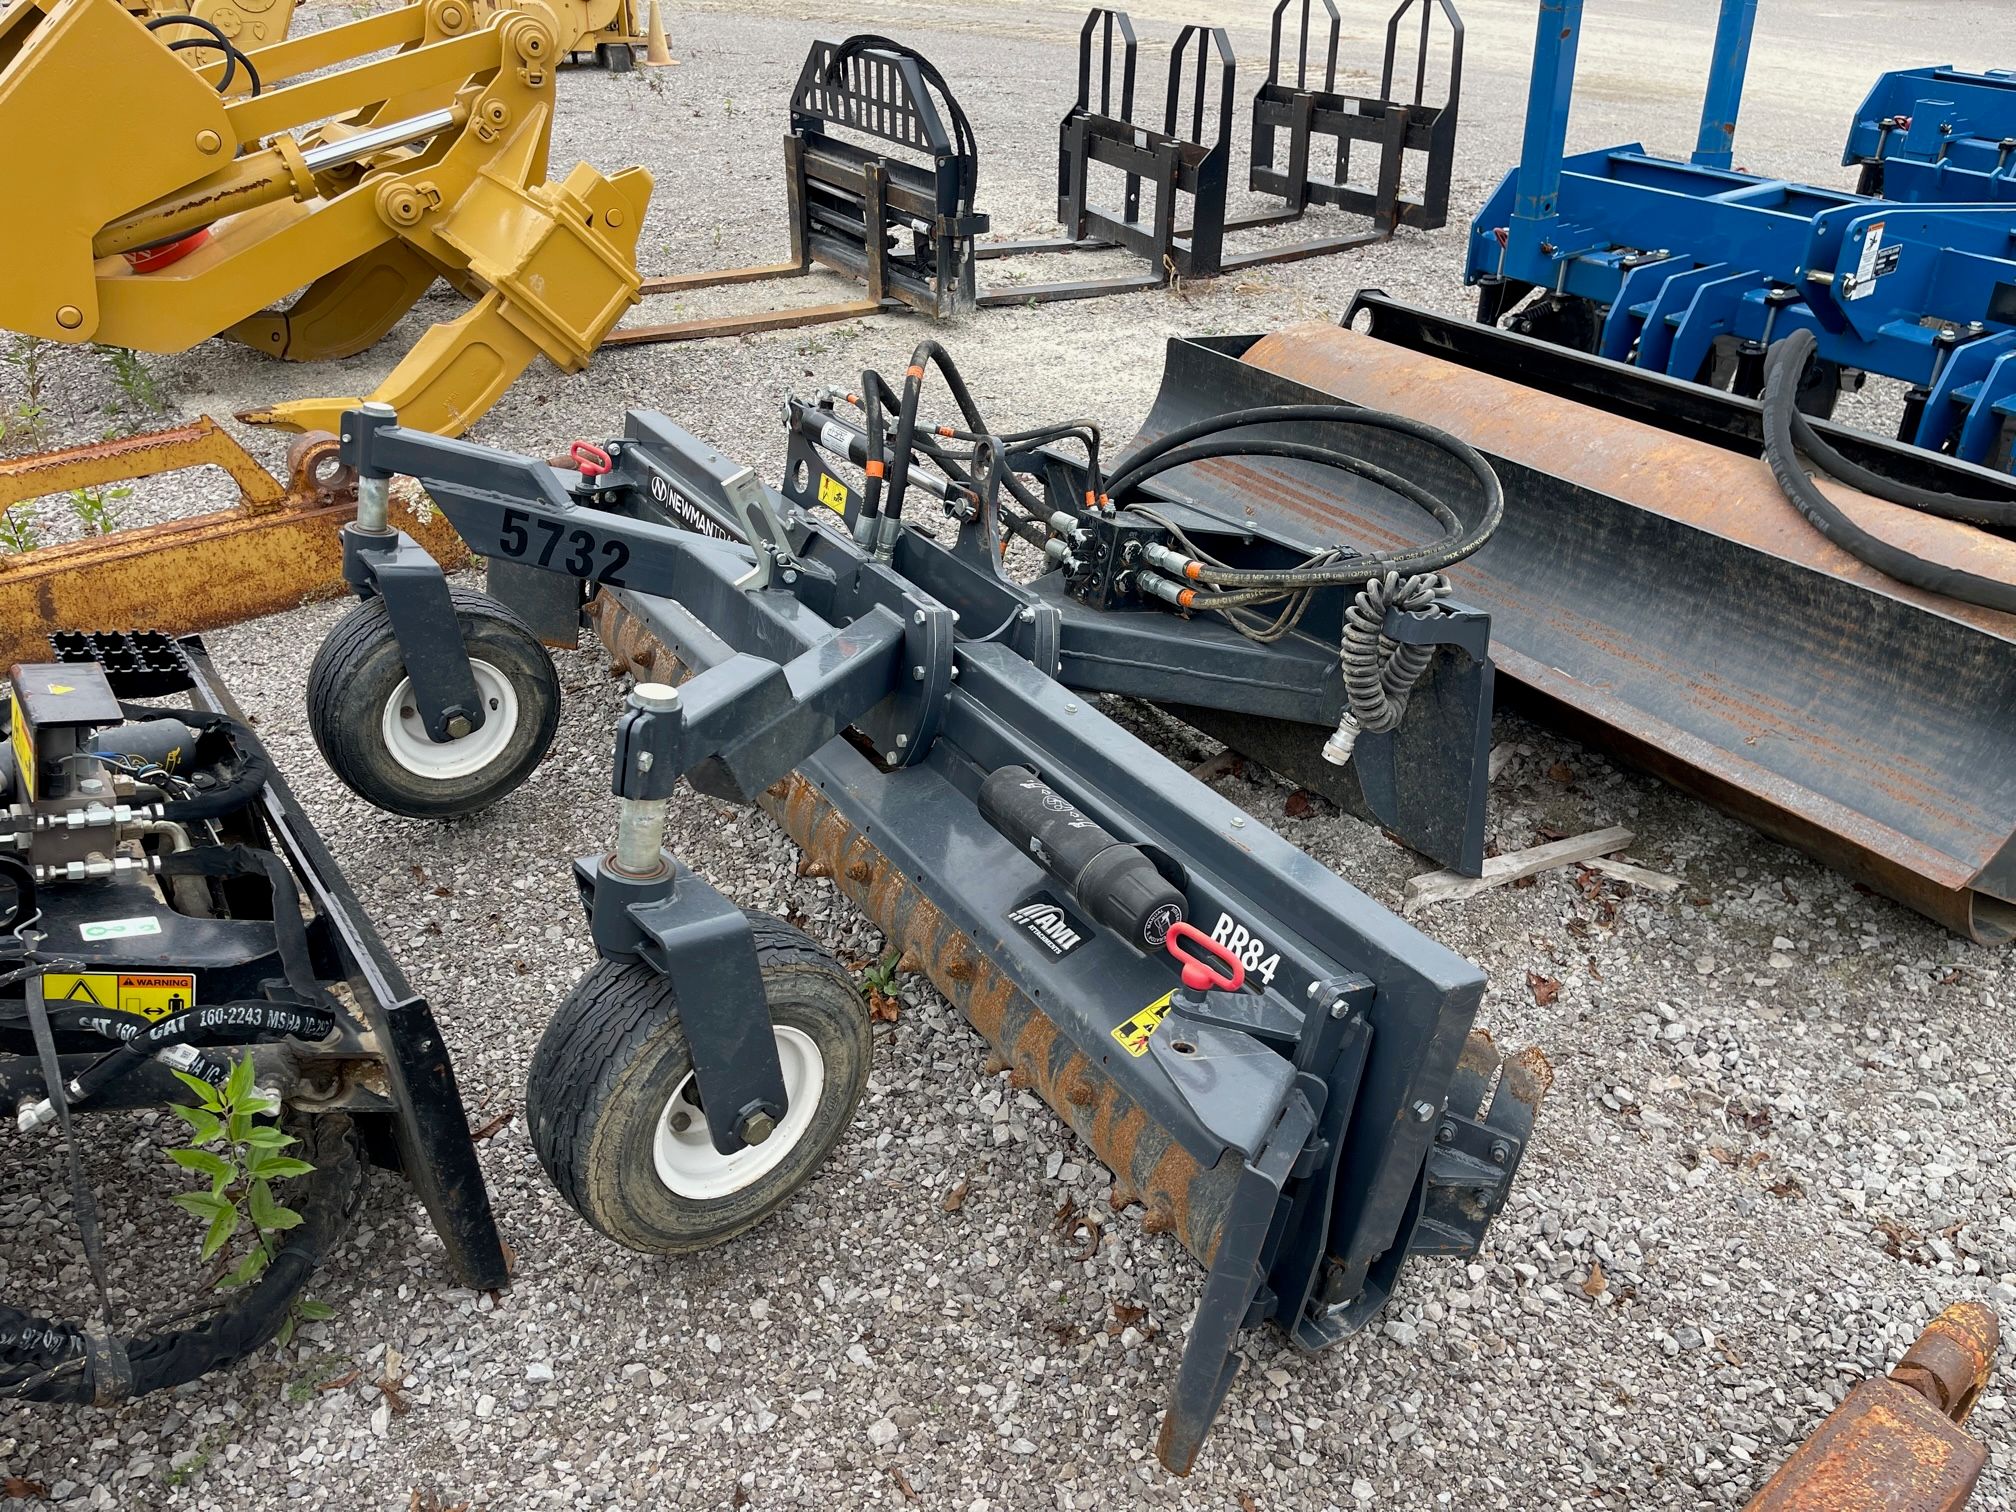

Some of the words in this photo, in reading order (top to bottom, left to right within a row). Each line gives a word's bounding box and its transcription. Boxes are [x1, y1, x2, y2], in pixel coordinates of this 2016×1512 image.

[499, 508, 630, 588] 5732
[1028, 924, 1063, 956] ATTACHMENTS
[1034, 912, 1082, 951] AMI
[1210, 911, 1281, 985] RR84
[137, 978, 189, 987] WARNING
[150, 1013, 191, 1041] CAT
[200, 1007, 262, 1027] 160-2243
[266, 1009, 302, 1032] MSHA
